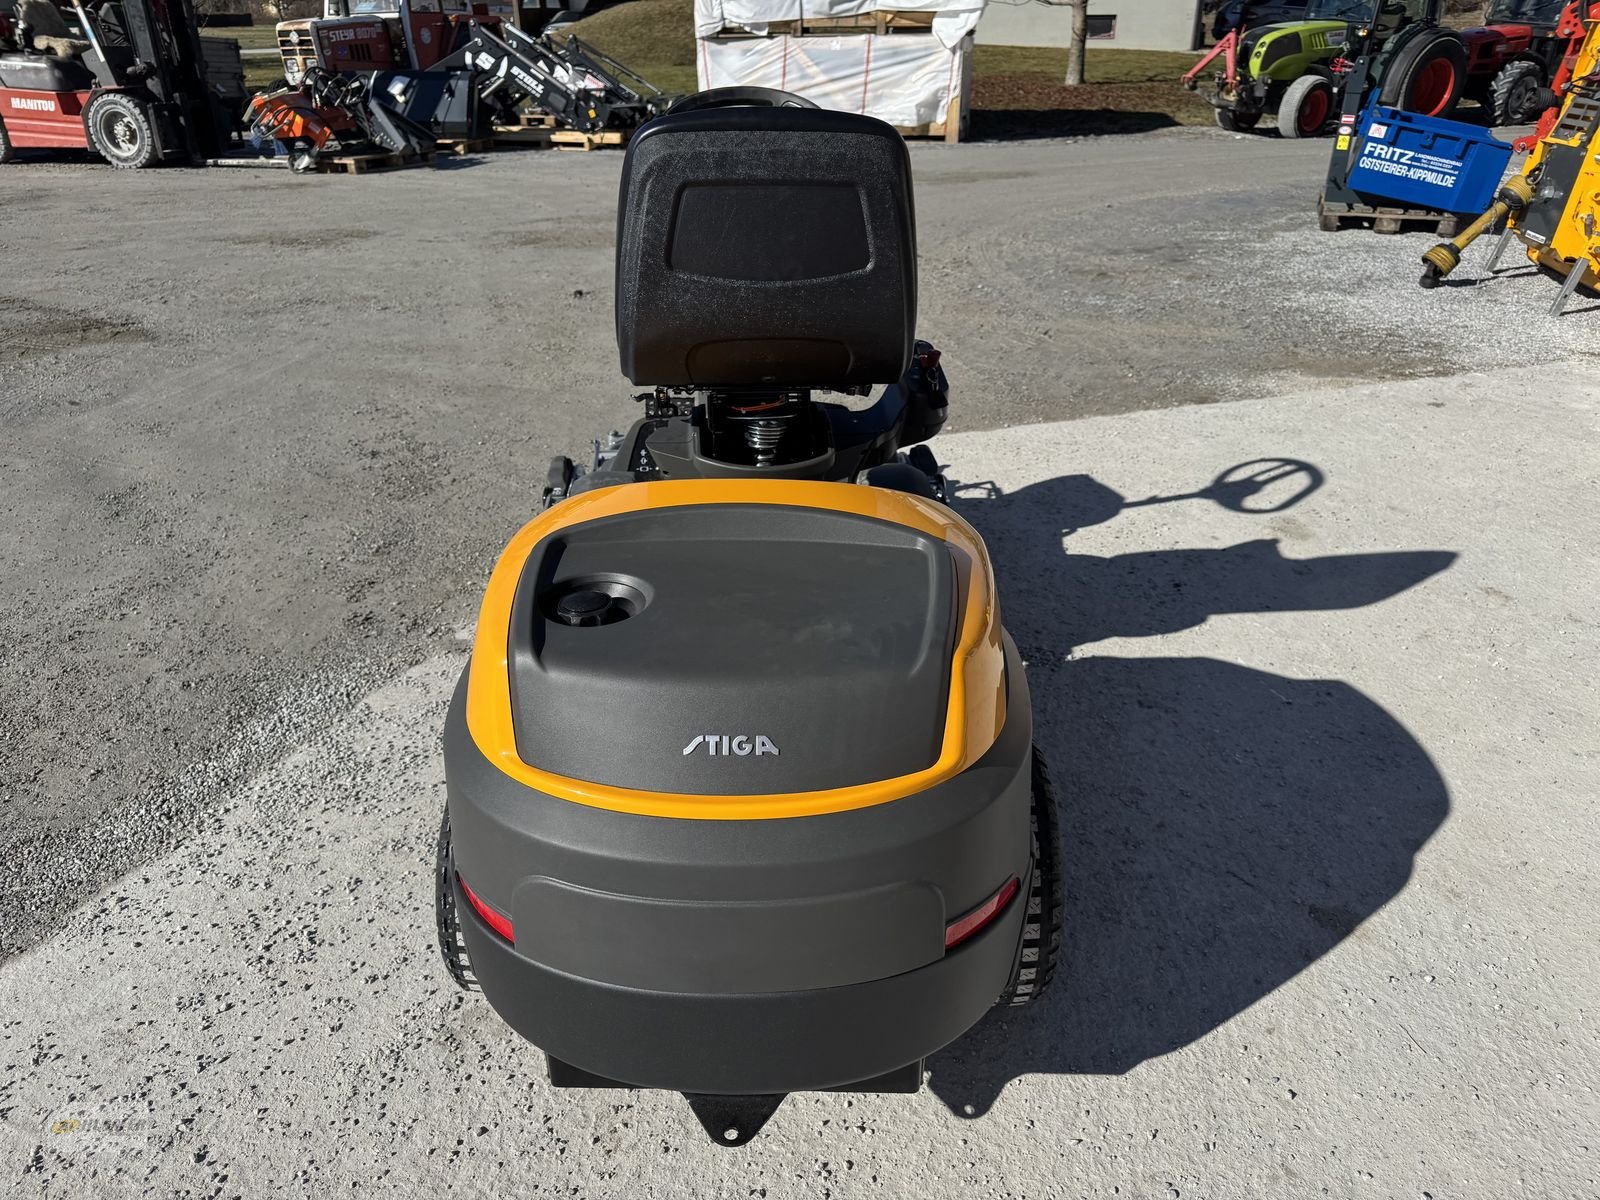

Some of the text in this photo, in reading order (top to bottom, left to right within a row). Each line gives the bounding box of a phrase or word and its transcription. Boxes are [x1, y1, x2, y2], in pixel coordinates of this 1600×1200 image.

[330, 29, 355, 42] STEYR
[11, 97, 55, 112] MANITOU
[1364, 142, 1415, 164] FRITZ
[1359, 157, 1456, 188] OSTSTEIRER-KIPPMULDE
[683, 735, 779, 756] STIGA
